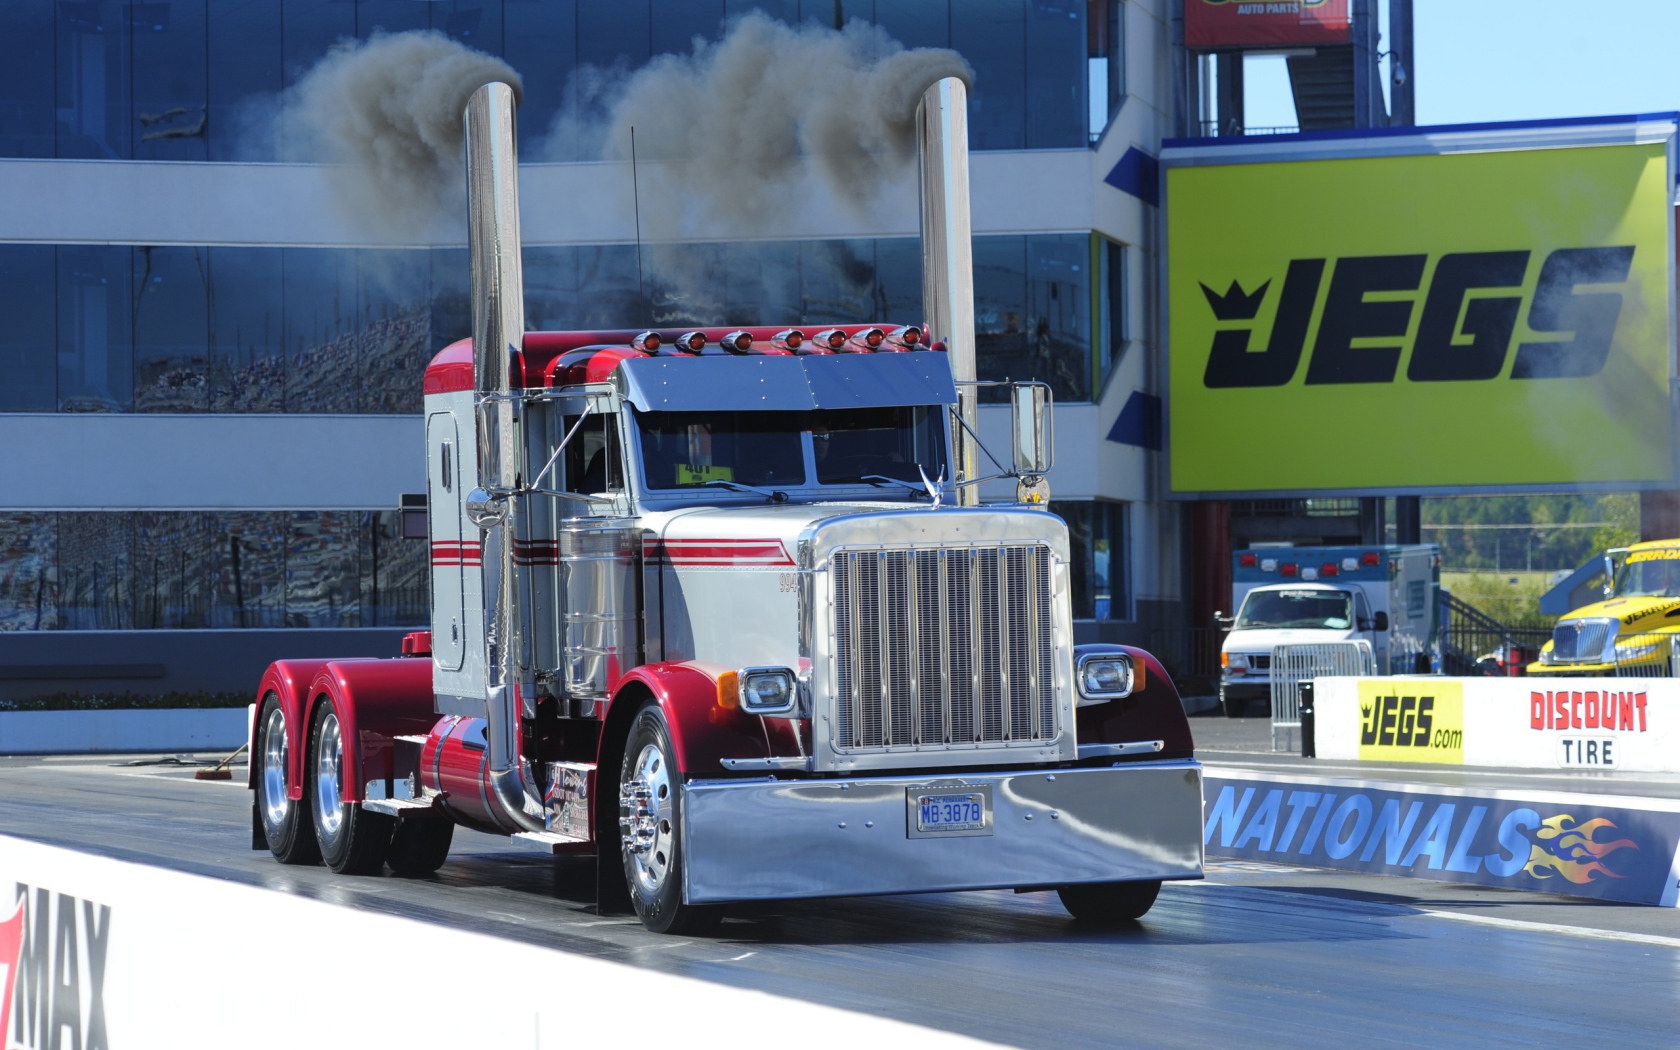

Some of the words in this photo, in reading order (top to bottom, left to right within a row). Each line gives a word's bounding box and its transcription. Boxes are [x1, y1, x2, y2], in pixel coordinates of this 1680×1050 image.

[1237, 4, 1264, 14] AUTO
[1266, 3, 1299, 14] PARTS
[1203, 246, 1636, 389] JEGS
[1360, 696, 1462, 750] JEGS.com
[1531, 690, 1648, 732] DISCOUNT
[1562, 740, 1614, 765] TIRE
[1204, 785, 1543, 877] NATIONALS
